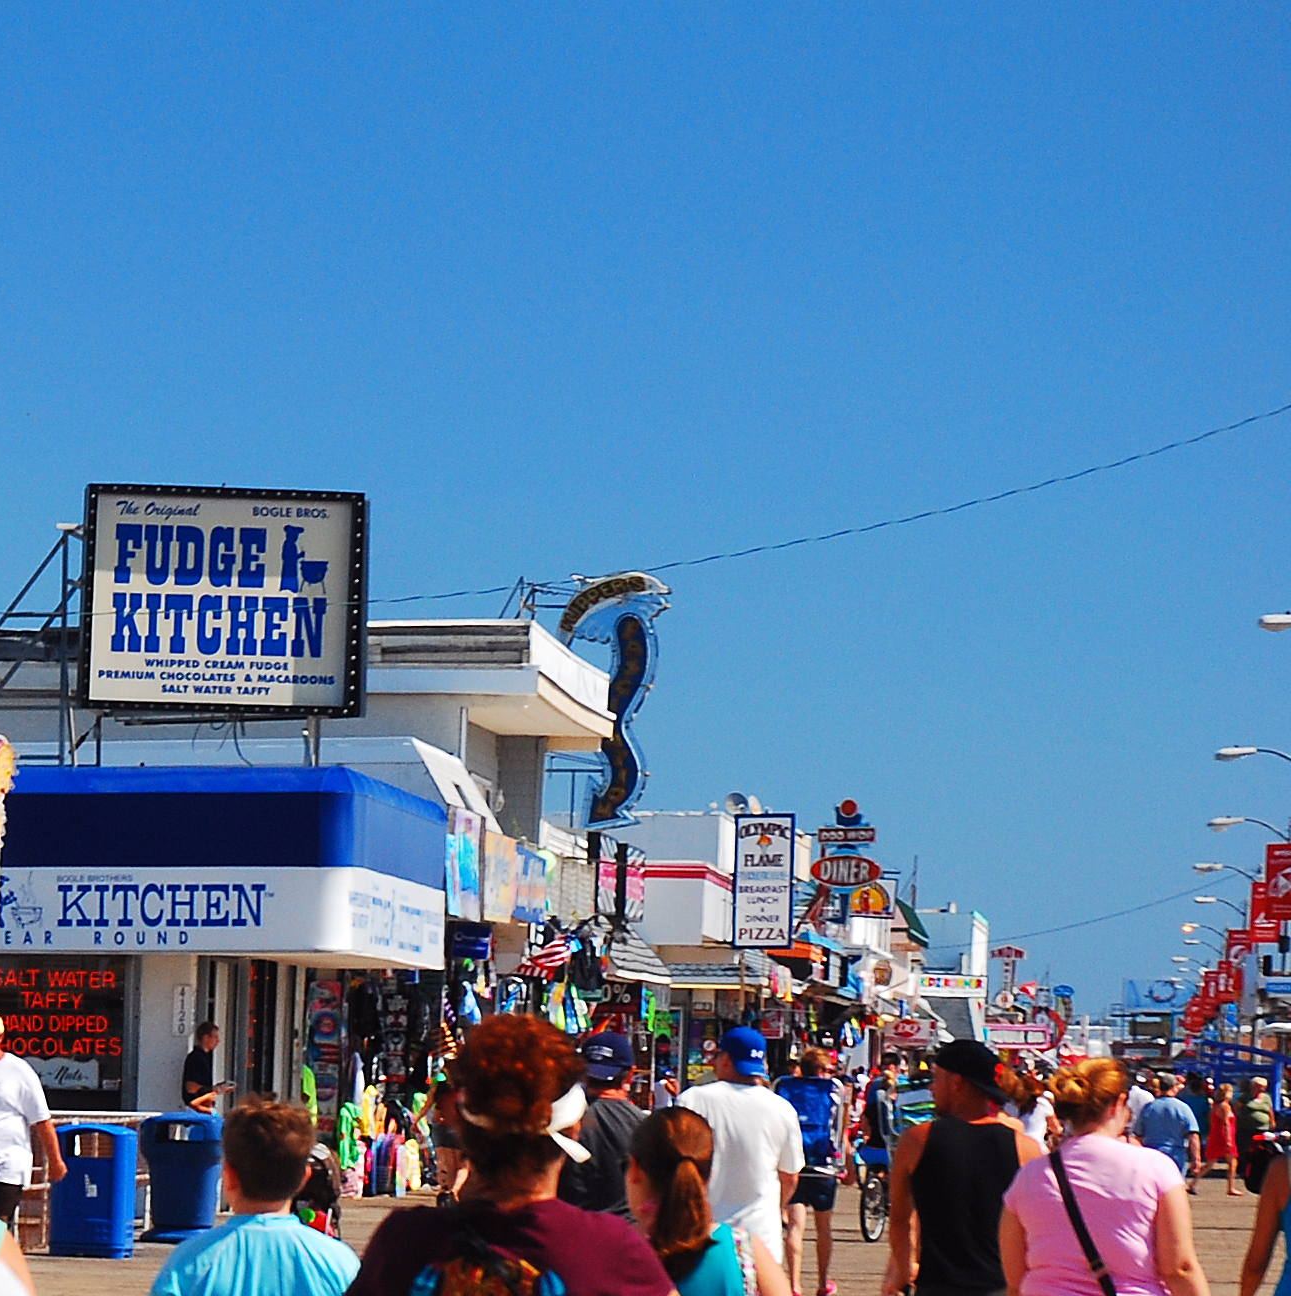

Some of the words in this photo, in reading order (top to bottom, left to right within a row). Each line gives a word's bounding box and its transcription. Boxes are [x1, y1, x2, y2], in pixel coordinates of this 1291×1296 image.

[116, 500, 140, 516] The
[144, 502, 201, 520] Original
[252, 506, 293, 518] BOGLE
[114, 523, 267, 589] FUDGE
[110, 592, 327, 658] KITCHEN
[145, 658, 200, 670] WHIPPED
[204, 659, 245, 671] CREAM
[250, 660, 289, 671] FUDGE
[98, 670, 156, 681] PREMIUM
[159, 671, 236, 683] CHOCOLATES
[257, 674, 336, 686] MACAROONS
[161, 684, 189, 695] SALT
[193, 685, 232, 695] WATER
[236, 685, 271, 696] TAFFY
[739, 822, 791, 840] OLYMPIC
[744, 853, 784, 867] FLAME
[820, 860, 870, 882] DINER
[57, 883, 266, 927] KITCHEN
[94, 930, 189, 945] ROUND
[739, 927, 786, 941] PIZZA
[48, 970, 117, 989] WATER
[20, 991, 84, 1010] TAFFY
[176, 986, 186, 1034] 4120
[49, 1014, 109, 1033] DIPPED
[0, 1037, 122, 1057] HOCOLATES
